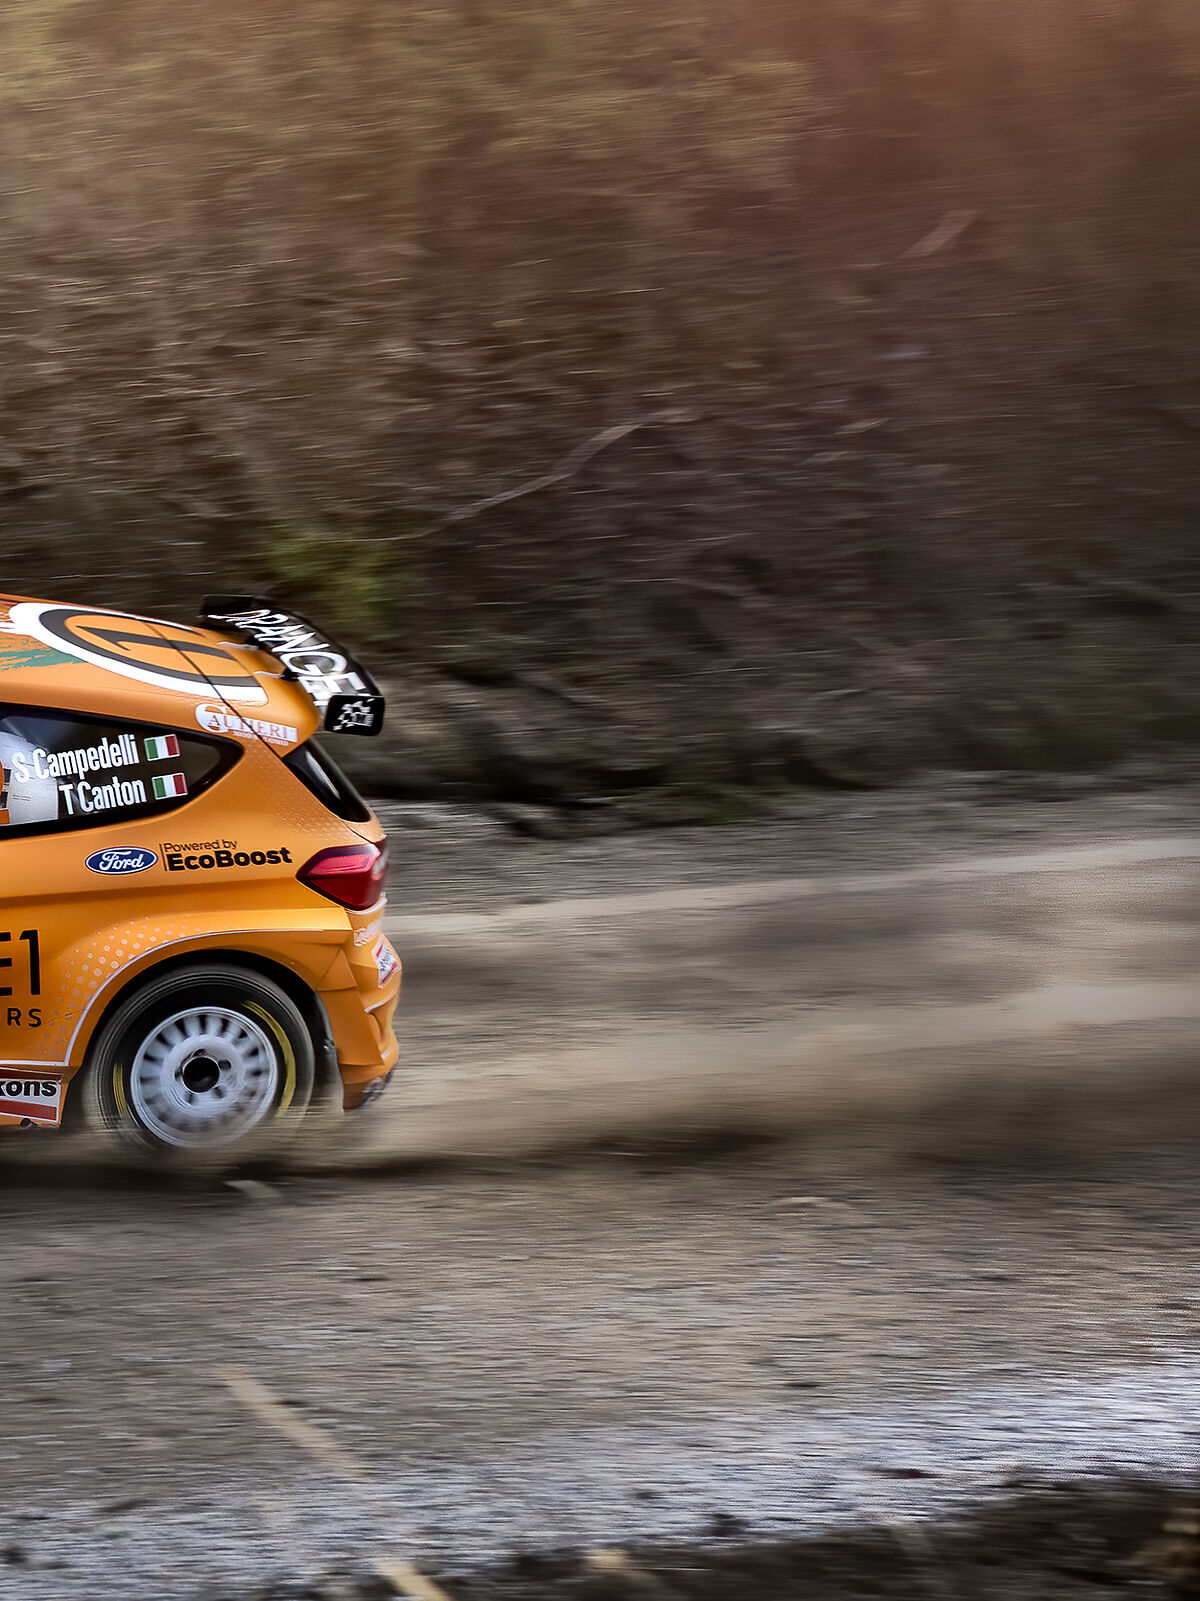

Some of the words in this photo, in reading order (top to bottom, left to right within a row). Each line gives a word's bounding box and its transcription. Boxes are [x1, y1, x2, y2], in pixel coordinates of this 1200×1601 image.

[33, 733, 140, 779] Campedelli
[58, 783, 75, 815] T
[76, 776, 147, 813] Canton
[164, 840, 220, 853] Powered
[221, 839, 238, 850] by
[99, 850, 145, 871] Ford
[166, 847, 293, 872] EcoBoost
